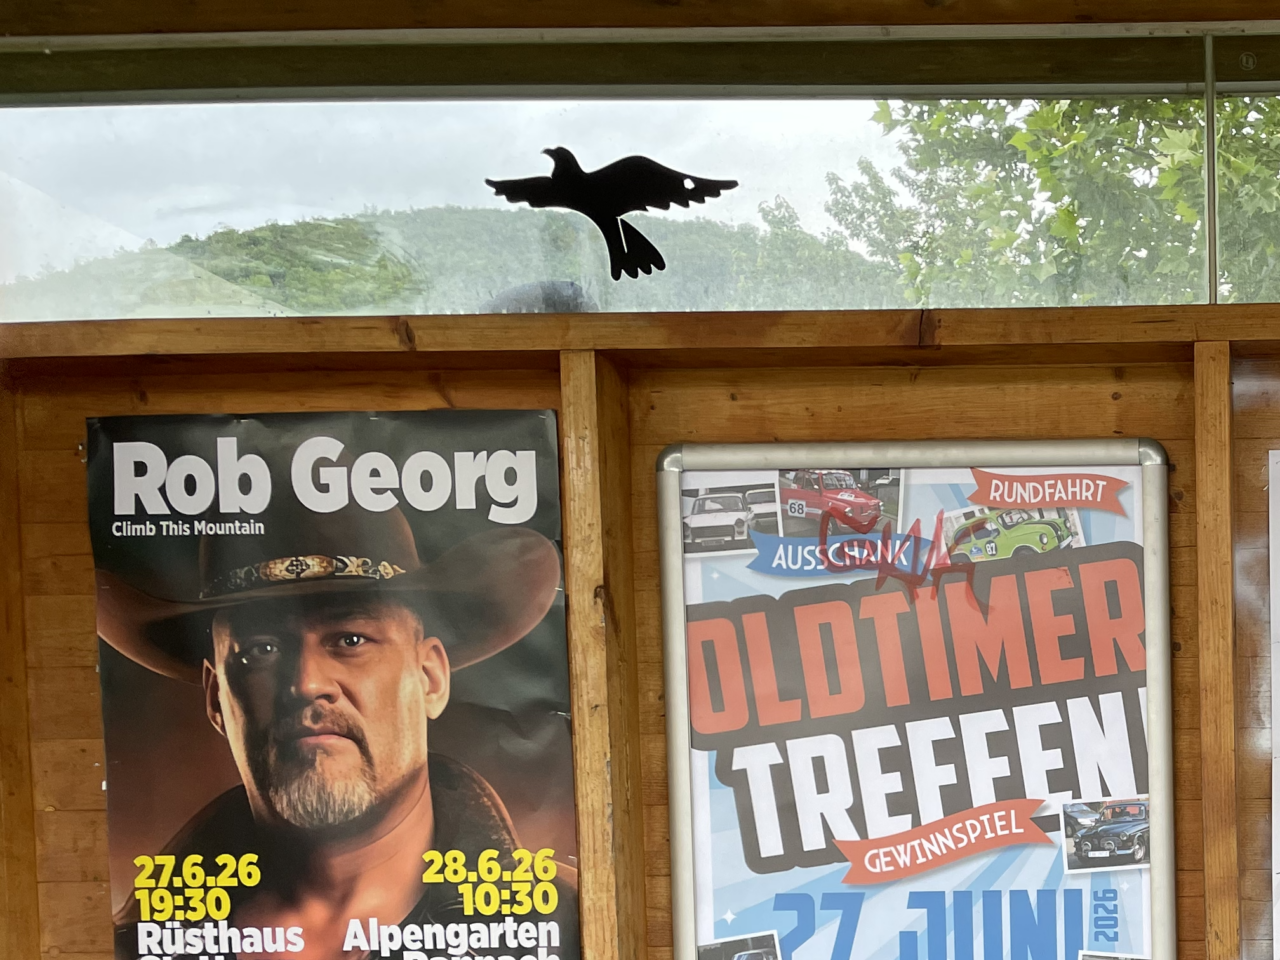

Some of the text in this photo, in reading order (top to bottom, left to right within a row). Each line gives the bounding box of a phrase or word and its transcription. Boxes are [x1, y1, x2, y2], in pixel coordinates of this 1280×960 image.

[113, 436, 538, 525] Rob Georg
[989, 479, 1107, 504] RUNDFAHRT
[788, 502, 805, 515] 68
[112, 519, 265, 537] Climb This Mountain
[772, 539, 911, 571] AUSSCHANK
[686, 557, 1148, 735] OLDTIMER
[864, 808, 1025, 874] GEWINNSPIEL
[133, 853, 261, 888] 27.6.26
[422, 847, 558, 883] 28.6.26
[134, 887, 231, 922] 19:30
[458, 881, 559, 916] 10:30
[1092, 888, 1119, 943] 2026
[137, 920, 305, 955] Rüsthaus
[342, 916, 560, 957] Alpengarten
